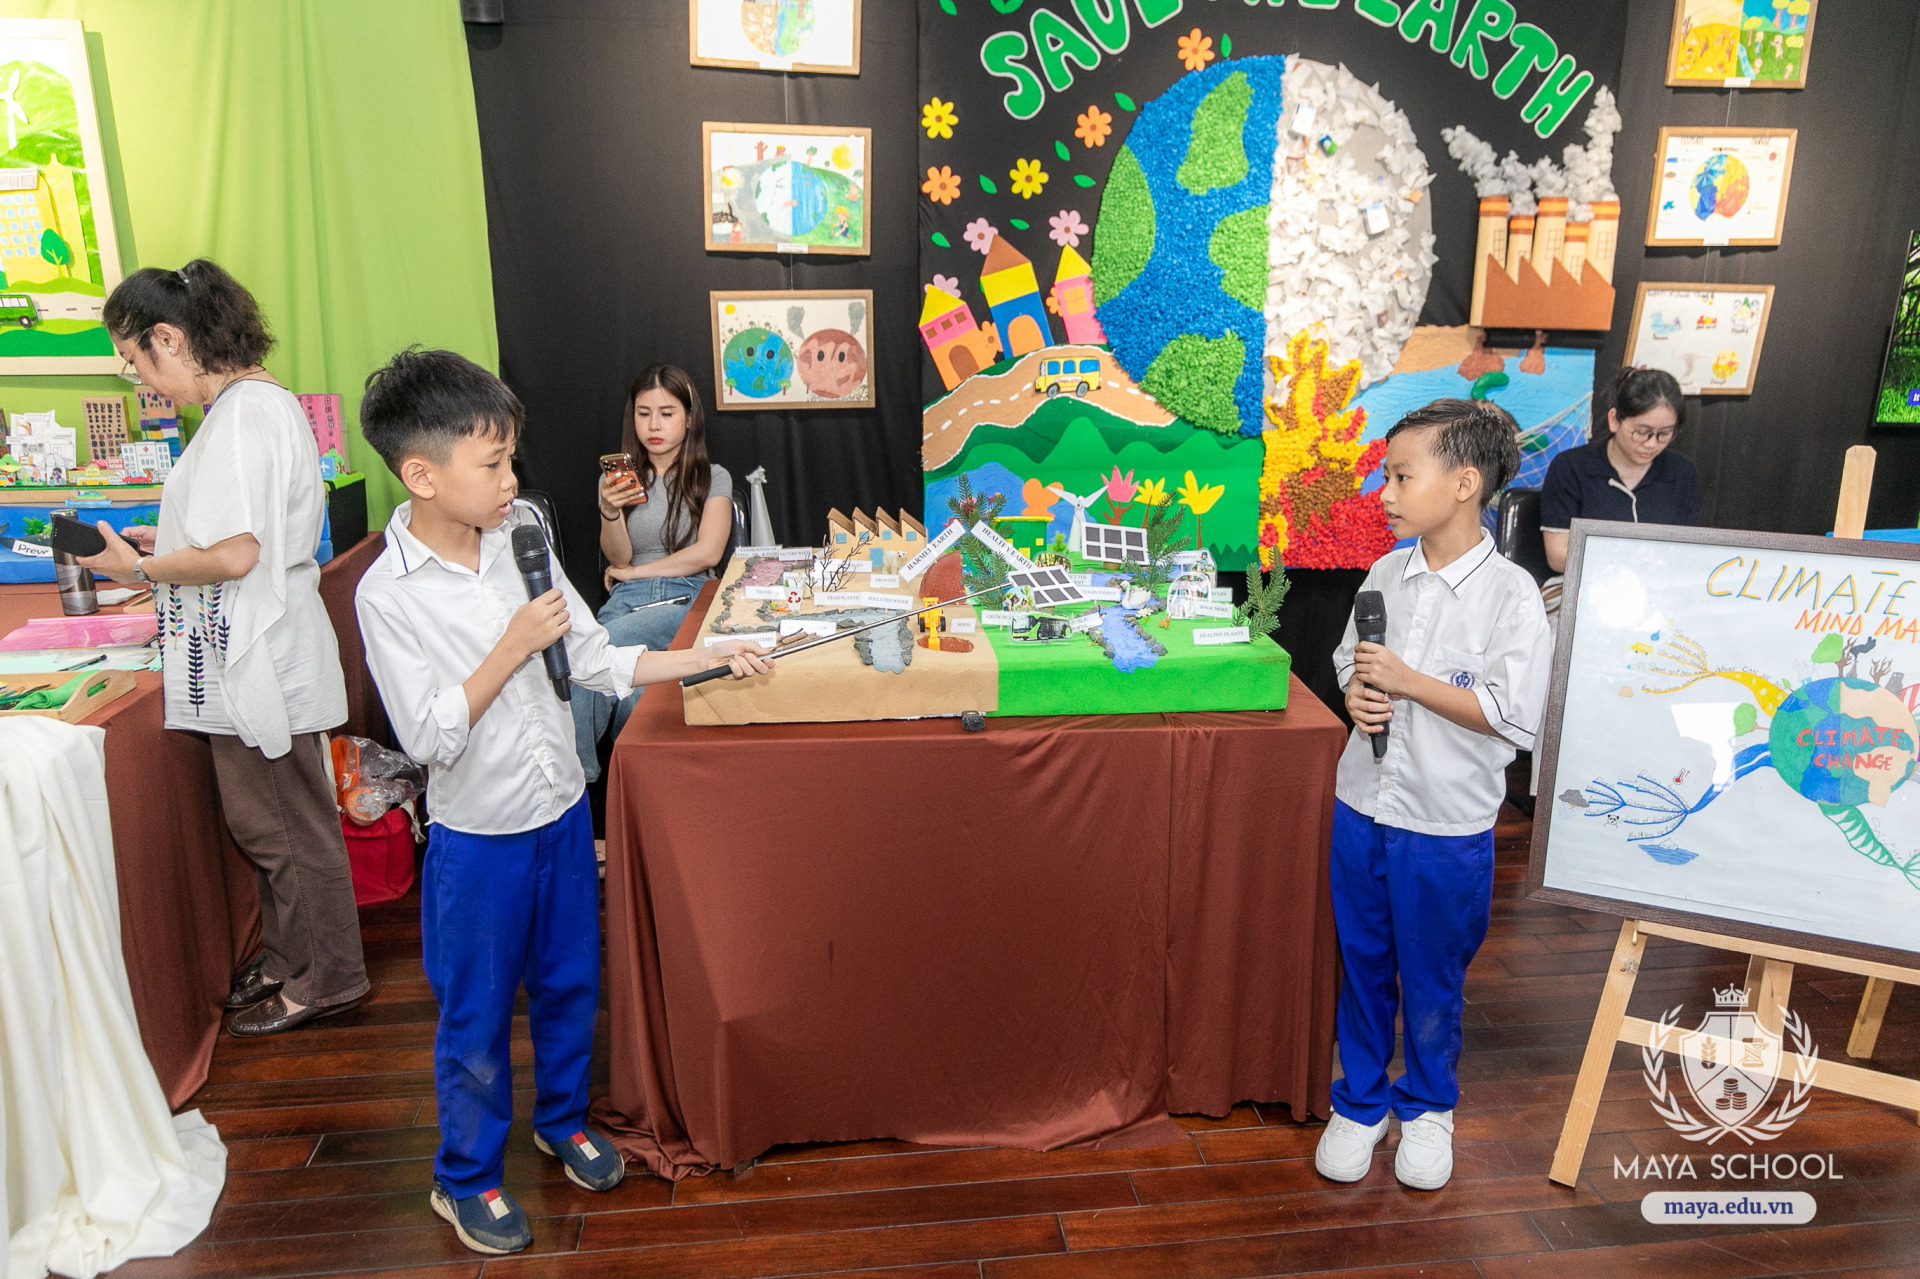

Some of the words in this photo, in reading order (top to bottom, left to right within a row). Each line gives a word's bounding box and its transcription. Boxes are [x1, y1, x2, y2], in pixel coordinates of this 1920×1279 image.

[932, 528, 954, 549] EARTH
[1010, 549, 1033, 570] EARTH
[1706, 555, 1917, 616] CLIMATE
[1794, 609, 1863, 636] MIND
[1873, 616, 1920, 644] MA
[1796, 724, 1905, 747] CLIMATE
[1813, 753, 1893, 771] CHANGE
